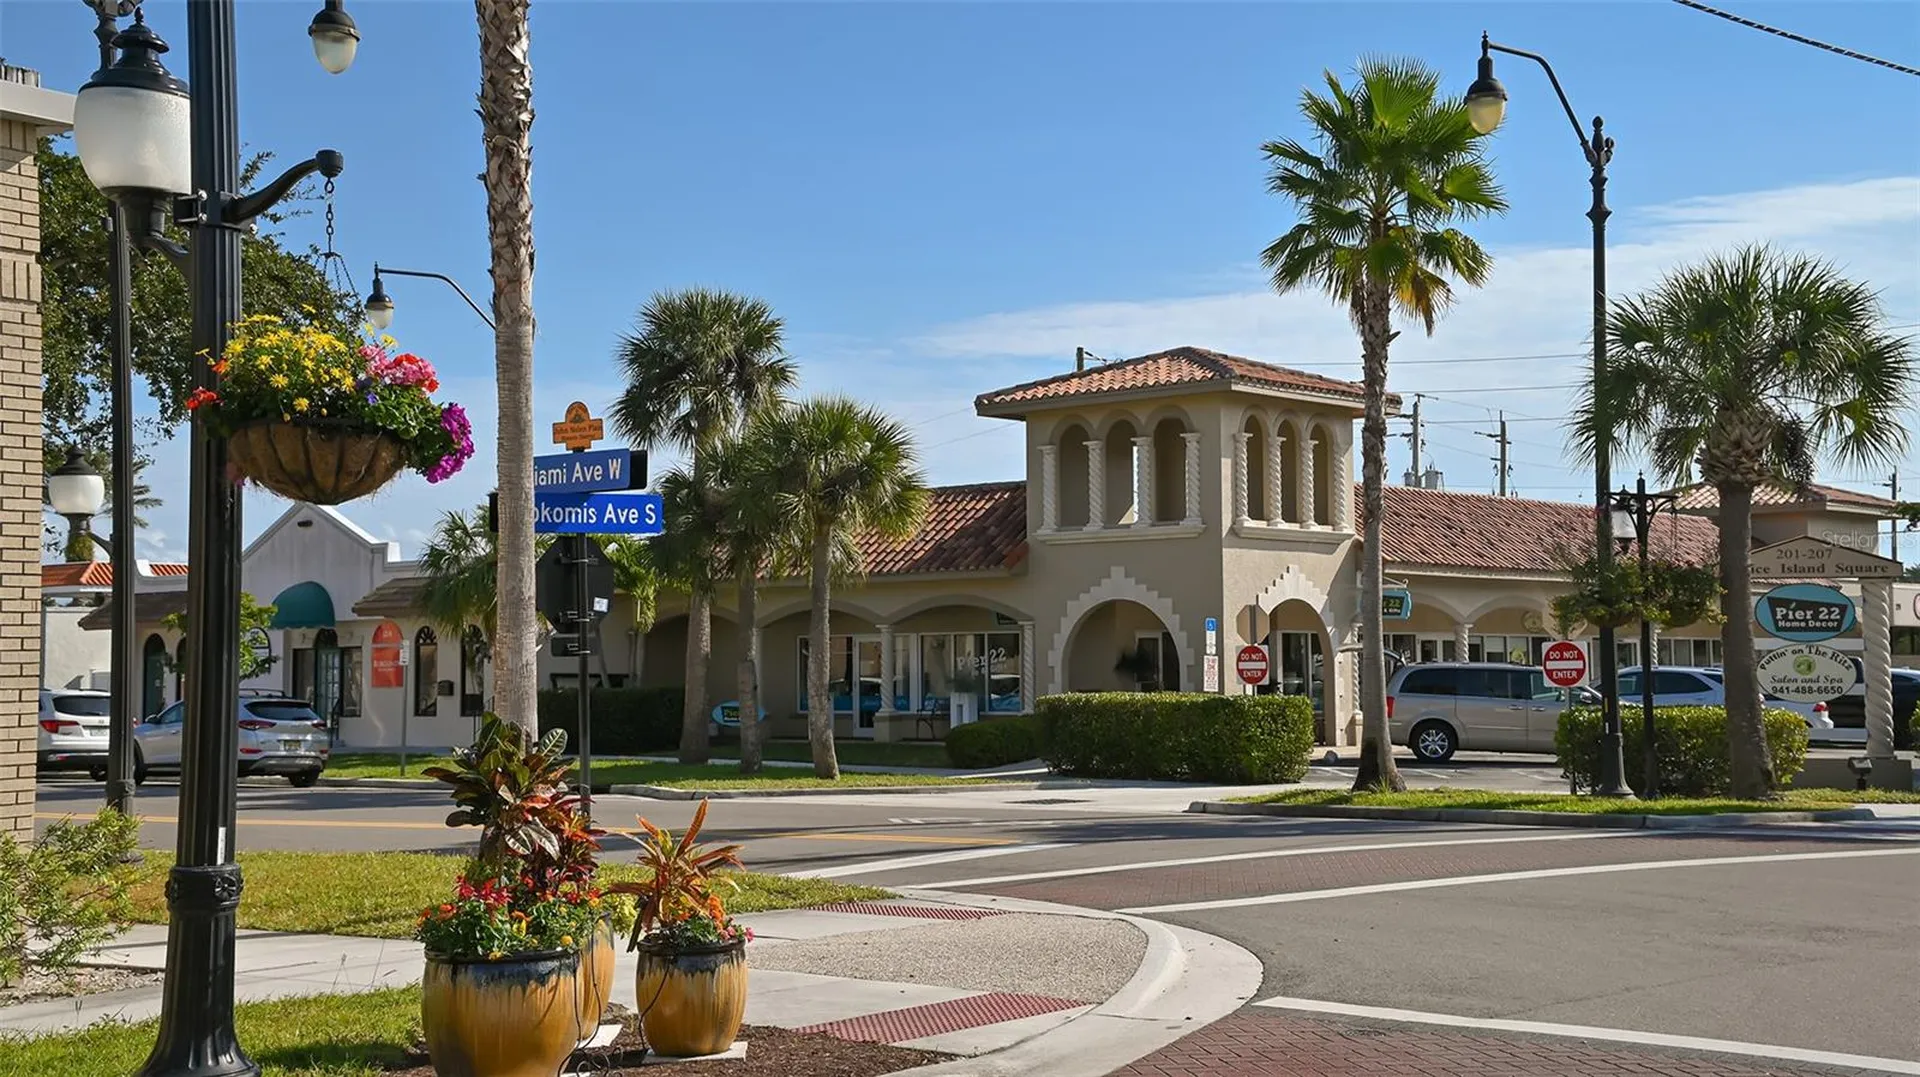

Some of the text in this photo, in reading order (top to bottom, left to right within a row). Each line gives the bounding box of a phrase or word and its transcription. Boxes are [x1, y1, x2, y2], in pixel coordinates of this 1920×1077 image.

[534, 458, 622, 486] iami Ave W
[533, 501, 656, 525] okomis Ave S
[1776, 549, 1833, 560] 201-207
[1750, 563, 1889, 576] ice Island Square
[1775, 601, 1841, 620] Pier 22
[1778, 620, 1839, 628] Home Decor
[990, 647, 1007, 664] 22
[1549, 650, 1578, 660] DO NOT
[1805, 644, 1828, 658] The
[1828, 650, 1853, 671] Ritz
[1243, 670, 1262, 678] ENTER
[1552, 670, 1578, 679] ENTER
[1770, 674, 1844, 685] Salon and Spa
[1771, 685, 1844, 695] 941-488-6650
